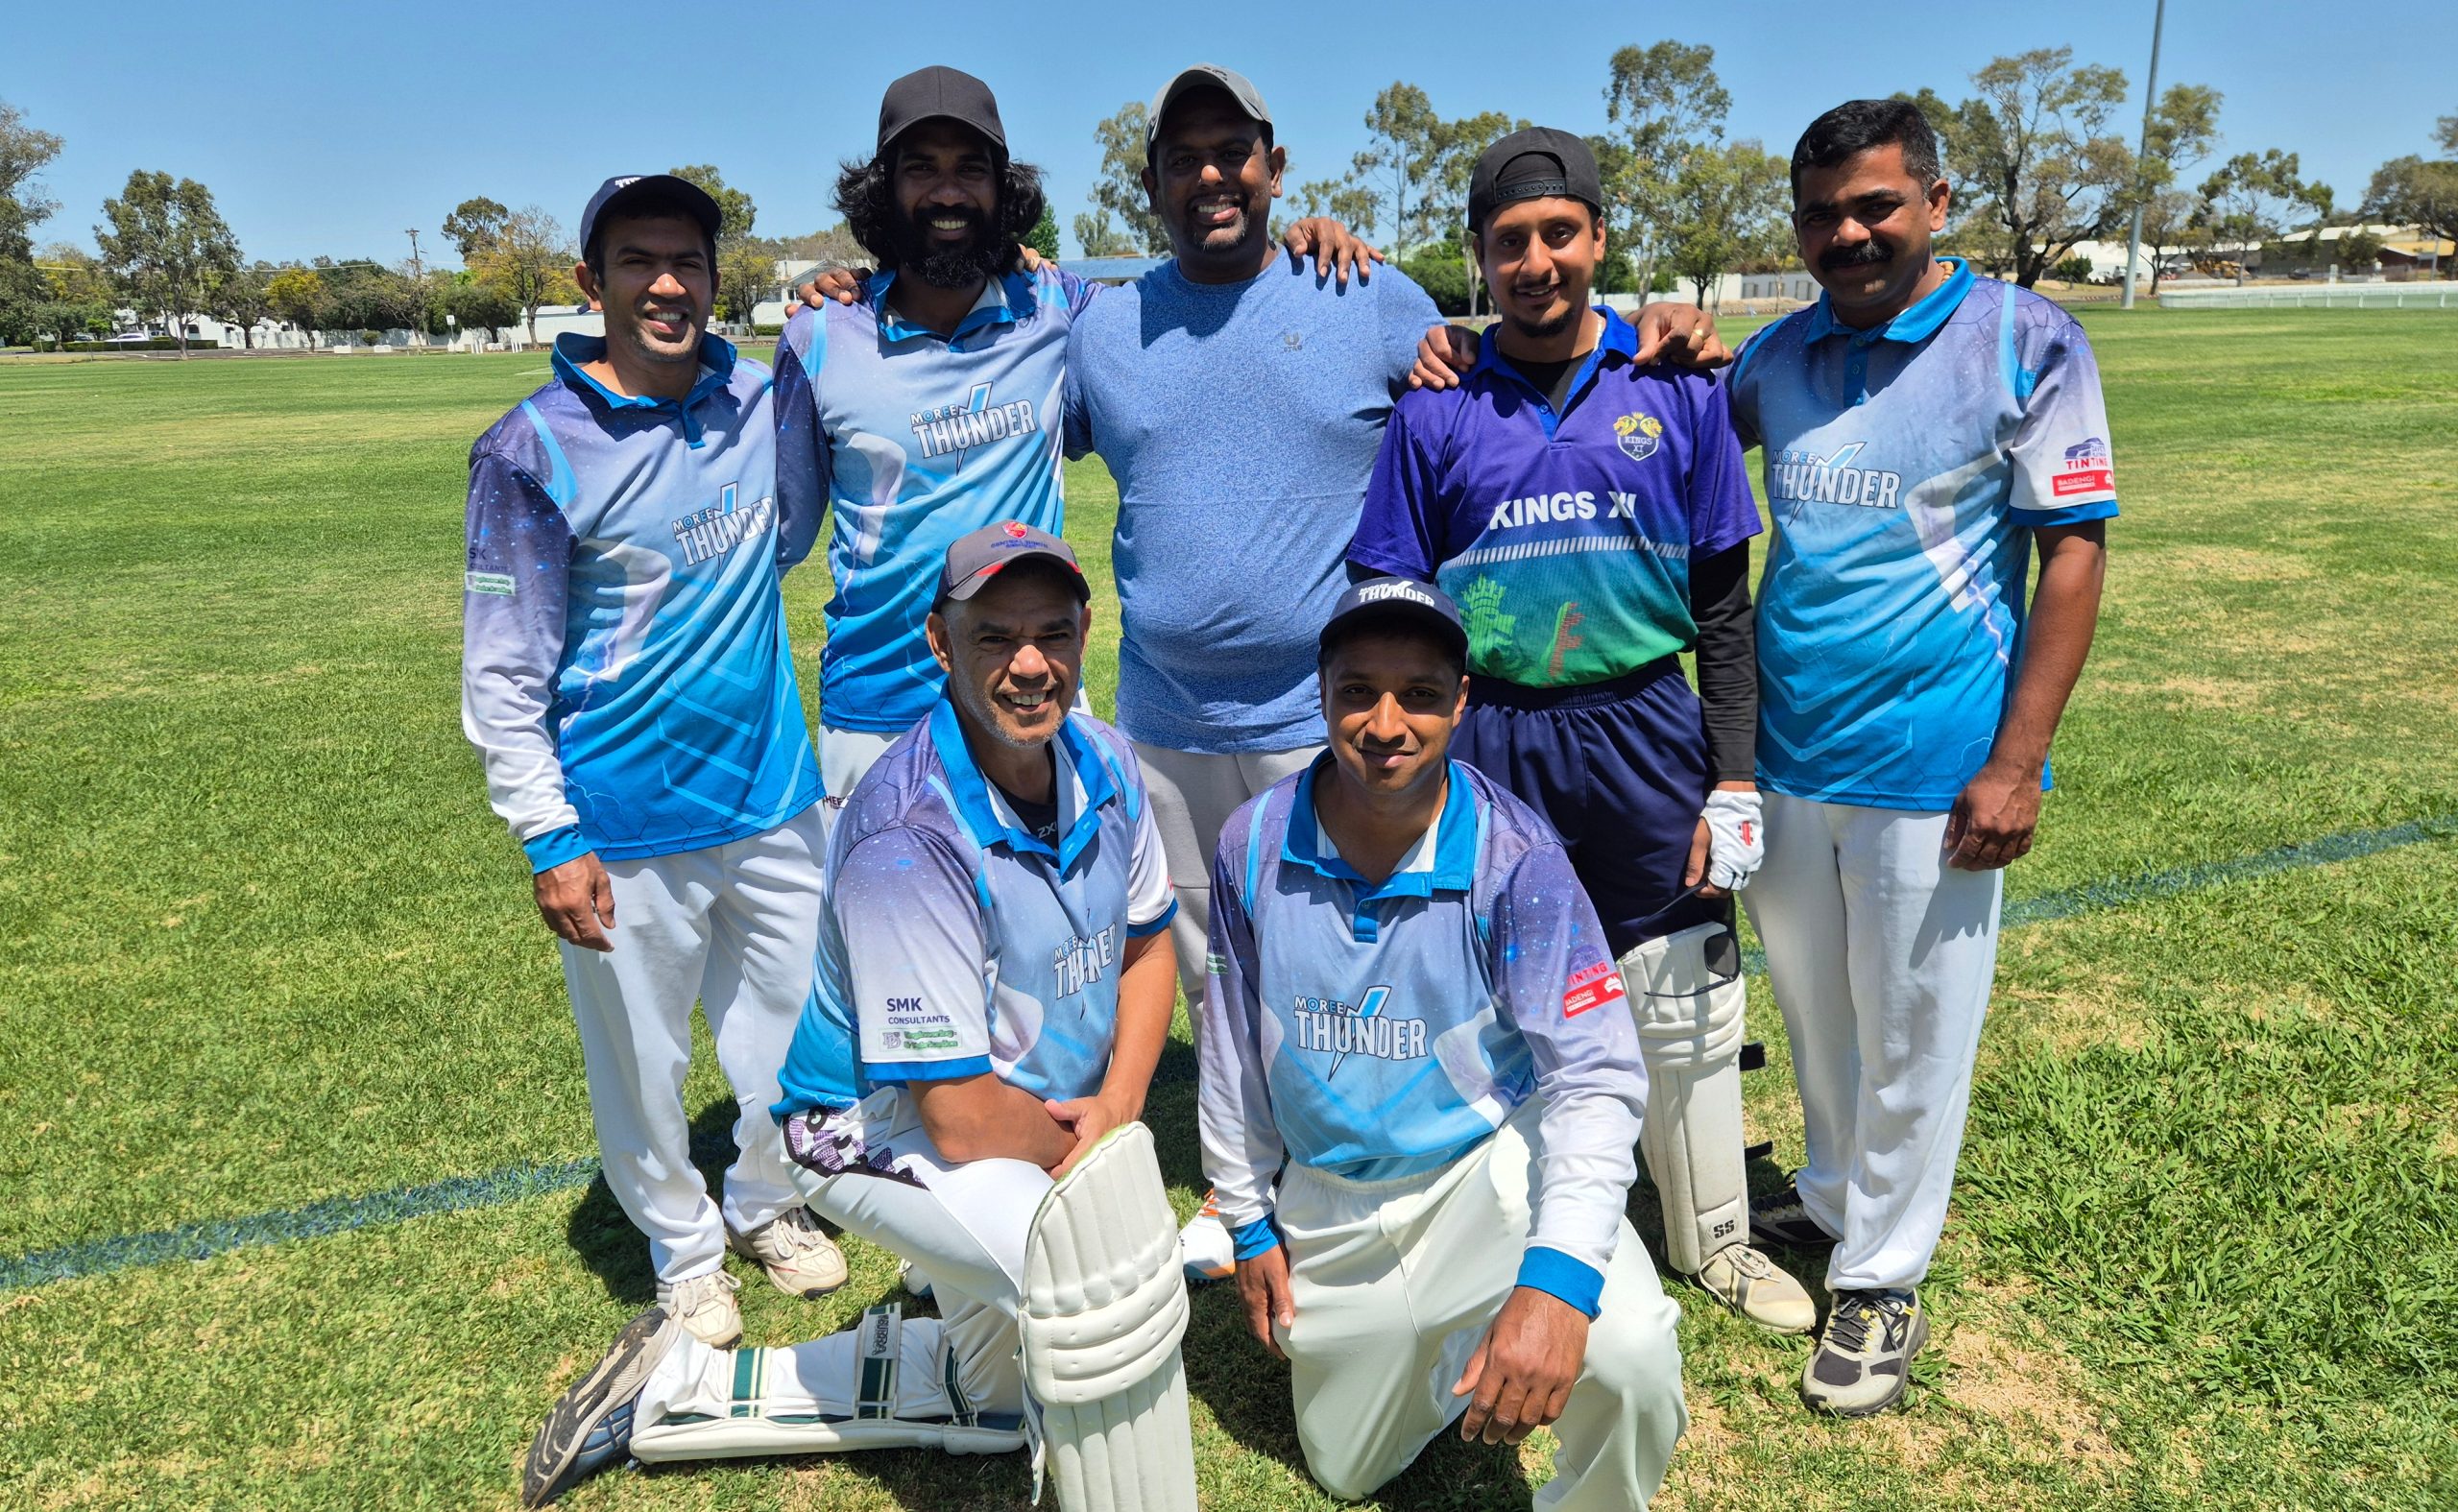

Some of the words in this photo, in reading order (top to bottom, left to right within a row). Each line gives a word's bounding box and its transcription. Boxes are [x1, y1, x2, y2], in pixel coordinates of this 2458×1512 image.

[910, 404, 958, 424] MOREE
[912, 399, 1037, 459] THUNDER
[1625, 436, 1652, 445] KINGS
[1772, 449, 1816, 464] MOREE
[1771, 463, 1901, 509] THUNDER
[672, 507, 713, 533] MOREE
[1489, 491, 1597, 531] KINGS
[1607, 491, 1637, 518] XI
[1359, 583, 1435, 607] THUNDER
[886, 996, 922, 1012] SMK
[1294, 996, 1344, 1015] MOREE
[888, 1015, 950, 1025] CONSULTANTS
[1293, 1010, 1429, 1060] THUNDER
[1713, 1219, 1735, 1239] SS
